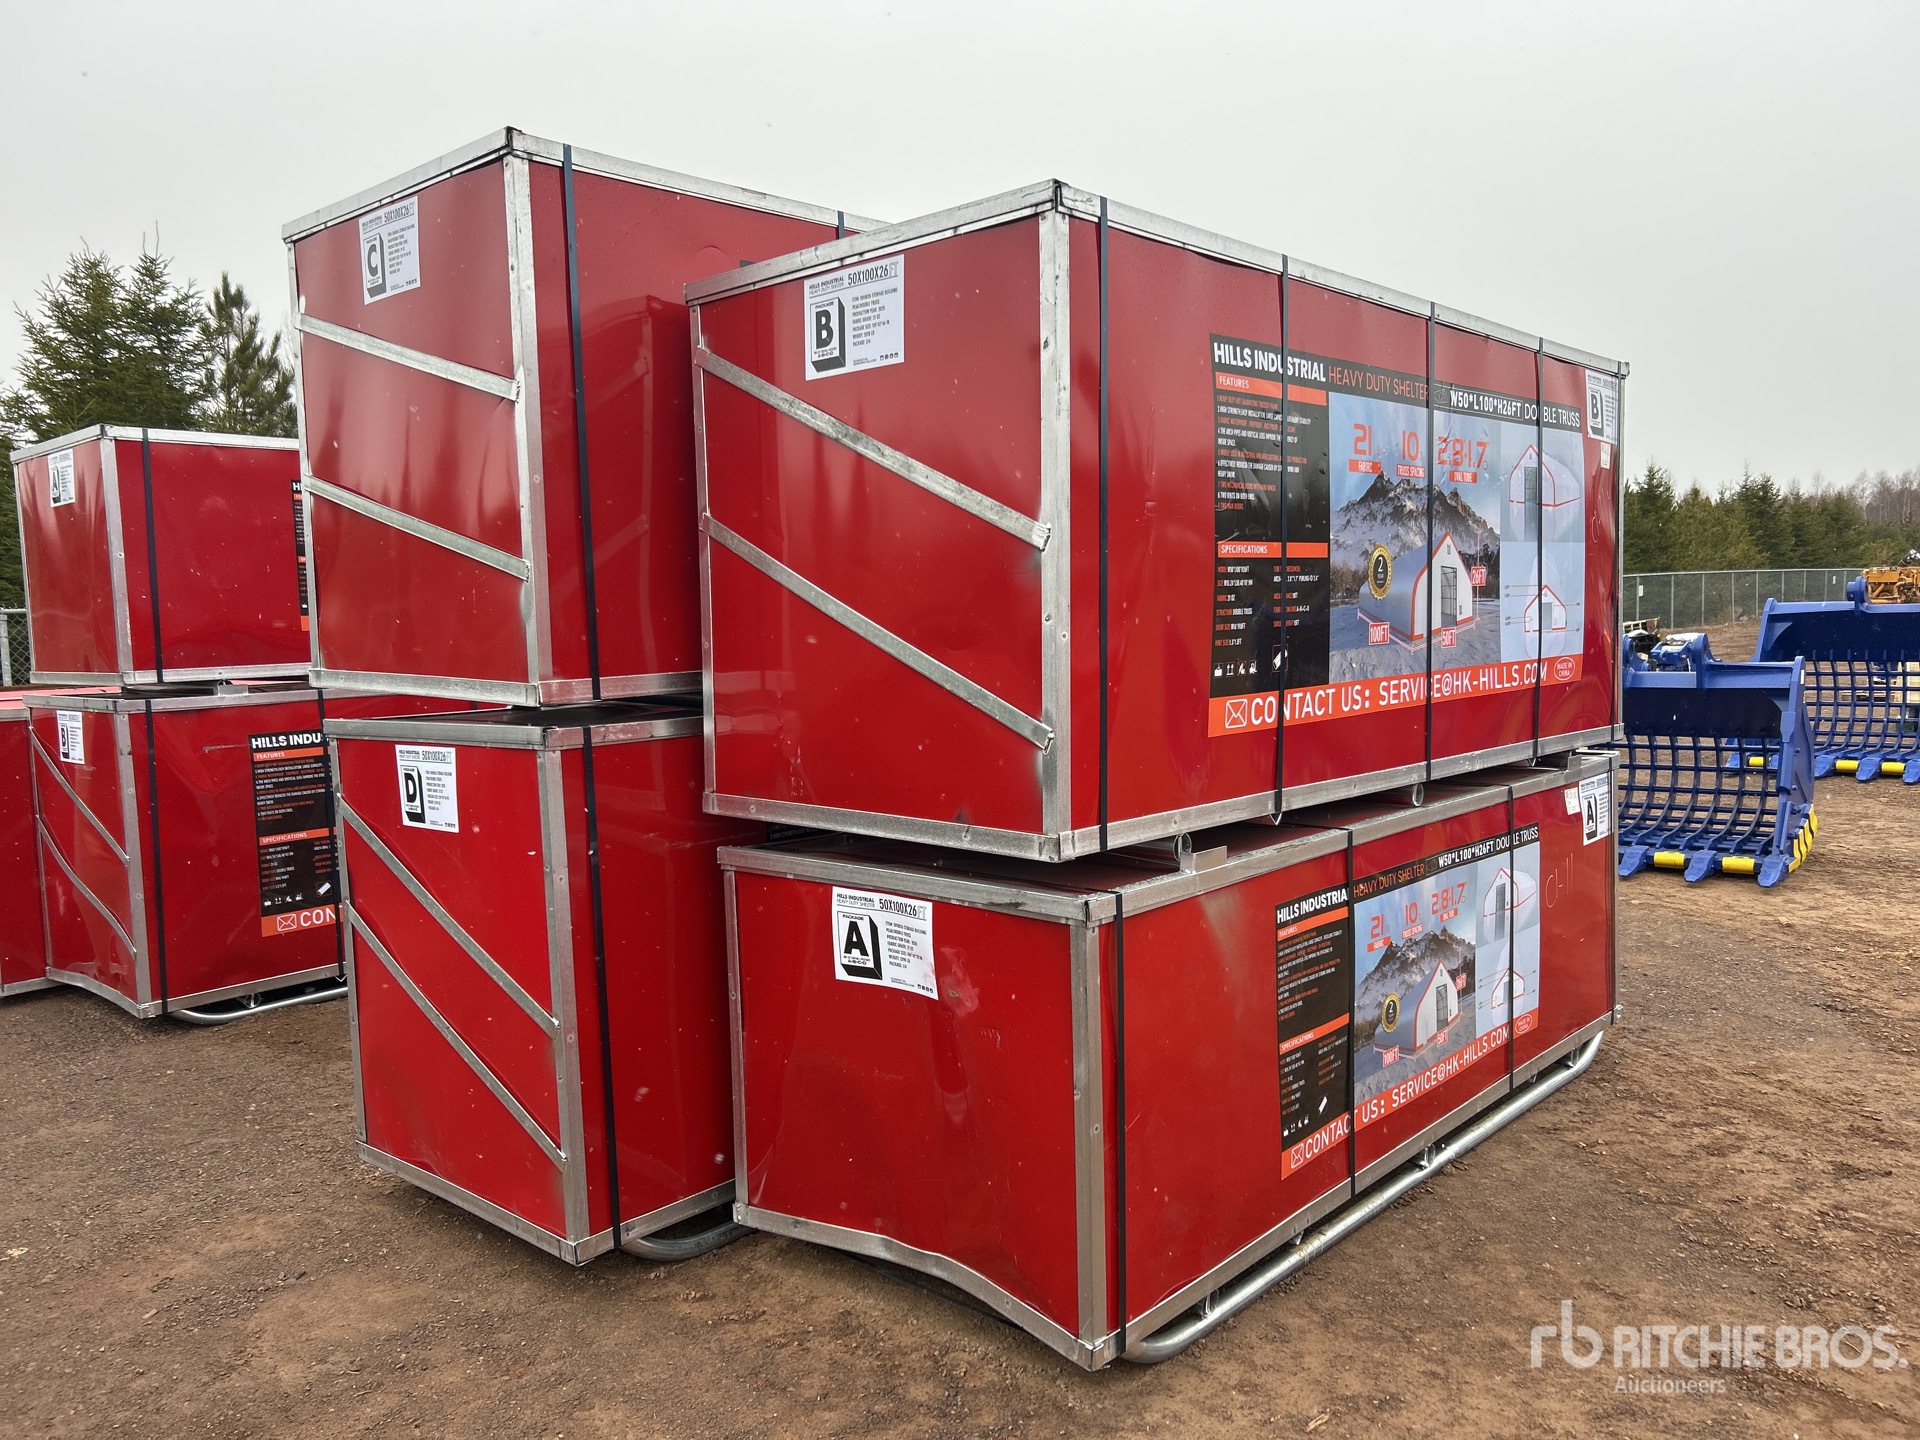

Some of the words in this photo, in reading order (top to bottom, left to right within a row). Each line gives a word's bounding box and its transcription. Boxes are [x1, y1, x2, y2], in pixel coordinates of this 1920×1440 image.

[367, 244, 379, 277] C
[821, 276, 844, 287] INDUSTRIAL
[814, 301, 835, 310] PACKAGE
[815, 309, 834, 350] B
[1214, 342, 1252, 368] HILLS
[1328, 366, 1363, 387] HEAVY
[1365, 373, 1391, 393] DUTY
[1393, 379, 1429, 401] SHELTER
[1219, 375, 1250, 390] FEATURES
[1524, 403, 1557, 423] DOBLE
[1557, 408, 1580, 428] TRUSS
[1590, 393, 1600, 420] B
[1353, 423, 1373, 456] 21
[1401, 430, 1420, 462] 10
[1397, 464, 1410, 476] TRUSS
[1409, 466, 1425, 478] SPACING
[1453, 471, 1463, 482] OVAL
[1463, 472, 1473, 482] TUBE
[1221, 544, 1268, 554] SPECIFICATIONS
[1378, 556, 1384, 572] 2
[1471, 568, 1486, 586] 26FT
[1370, 624, 1389, 644] 100FT
[1442, 629, 1456, 647] 50FT
[1557, 662, 1568, 670] MADE
[1567, 661, 1573, 669] IN
[1558, 670, 1571, 678] CHINA
[1341, 684, 1370, 712] US:
[251, 735, 288, 749] HILLS
[256, 751, 286, 760] FEATURES
[404, 772, 417, 804] D
[1586, 799, 1595, 826] A
[262, 832, 308, 844] SPECIFICATIONS
[1495, 832, 1520, 851] DOULE
[1520, 826, 1539, 843] TRUSS
[848, 894, 875, 903] INDUSTRIAL
[1277, 903, 1300, 924] HILLS
[1353, 878, 1379, 899] HEAVY
[1379, 872, 1397, 891] DUTY
[1397, 863, 1425, 883] SHELTER
[1405, 901, 1418, 926] 10
[1279, 925, 1298, 938] FEATURES
[1370, 913, 1385, 939] 21
[843, 920, 870, 957] A
[1388, 1001, 1394, 1013] 2
[1281, 1031, 1315, 1052] SPECIFICATIONS
[1437, 1029, 1448, 1046] 50FT
[1383, 1047, 1399, 1067] 100FT
[1362, 1099, 1385, 1123] US:
[1391, 1024, 1510, 1108] SERVICE@HK-HILLS.COM
